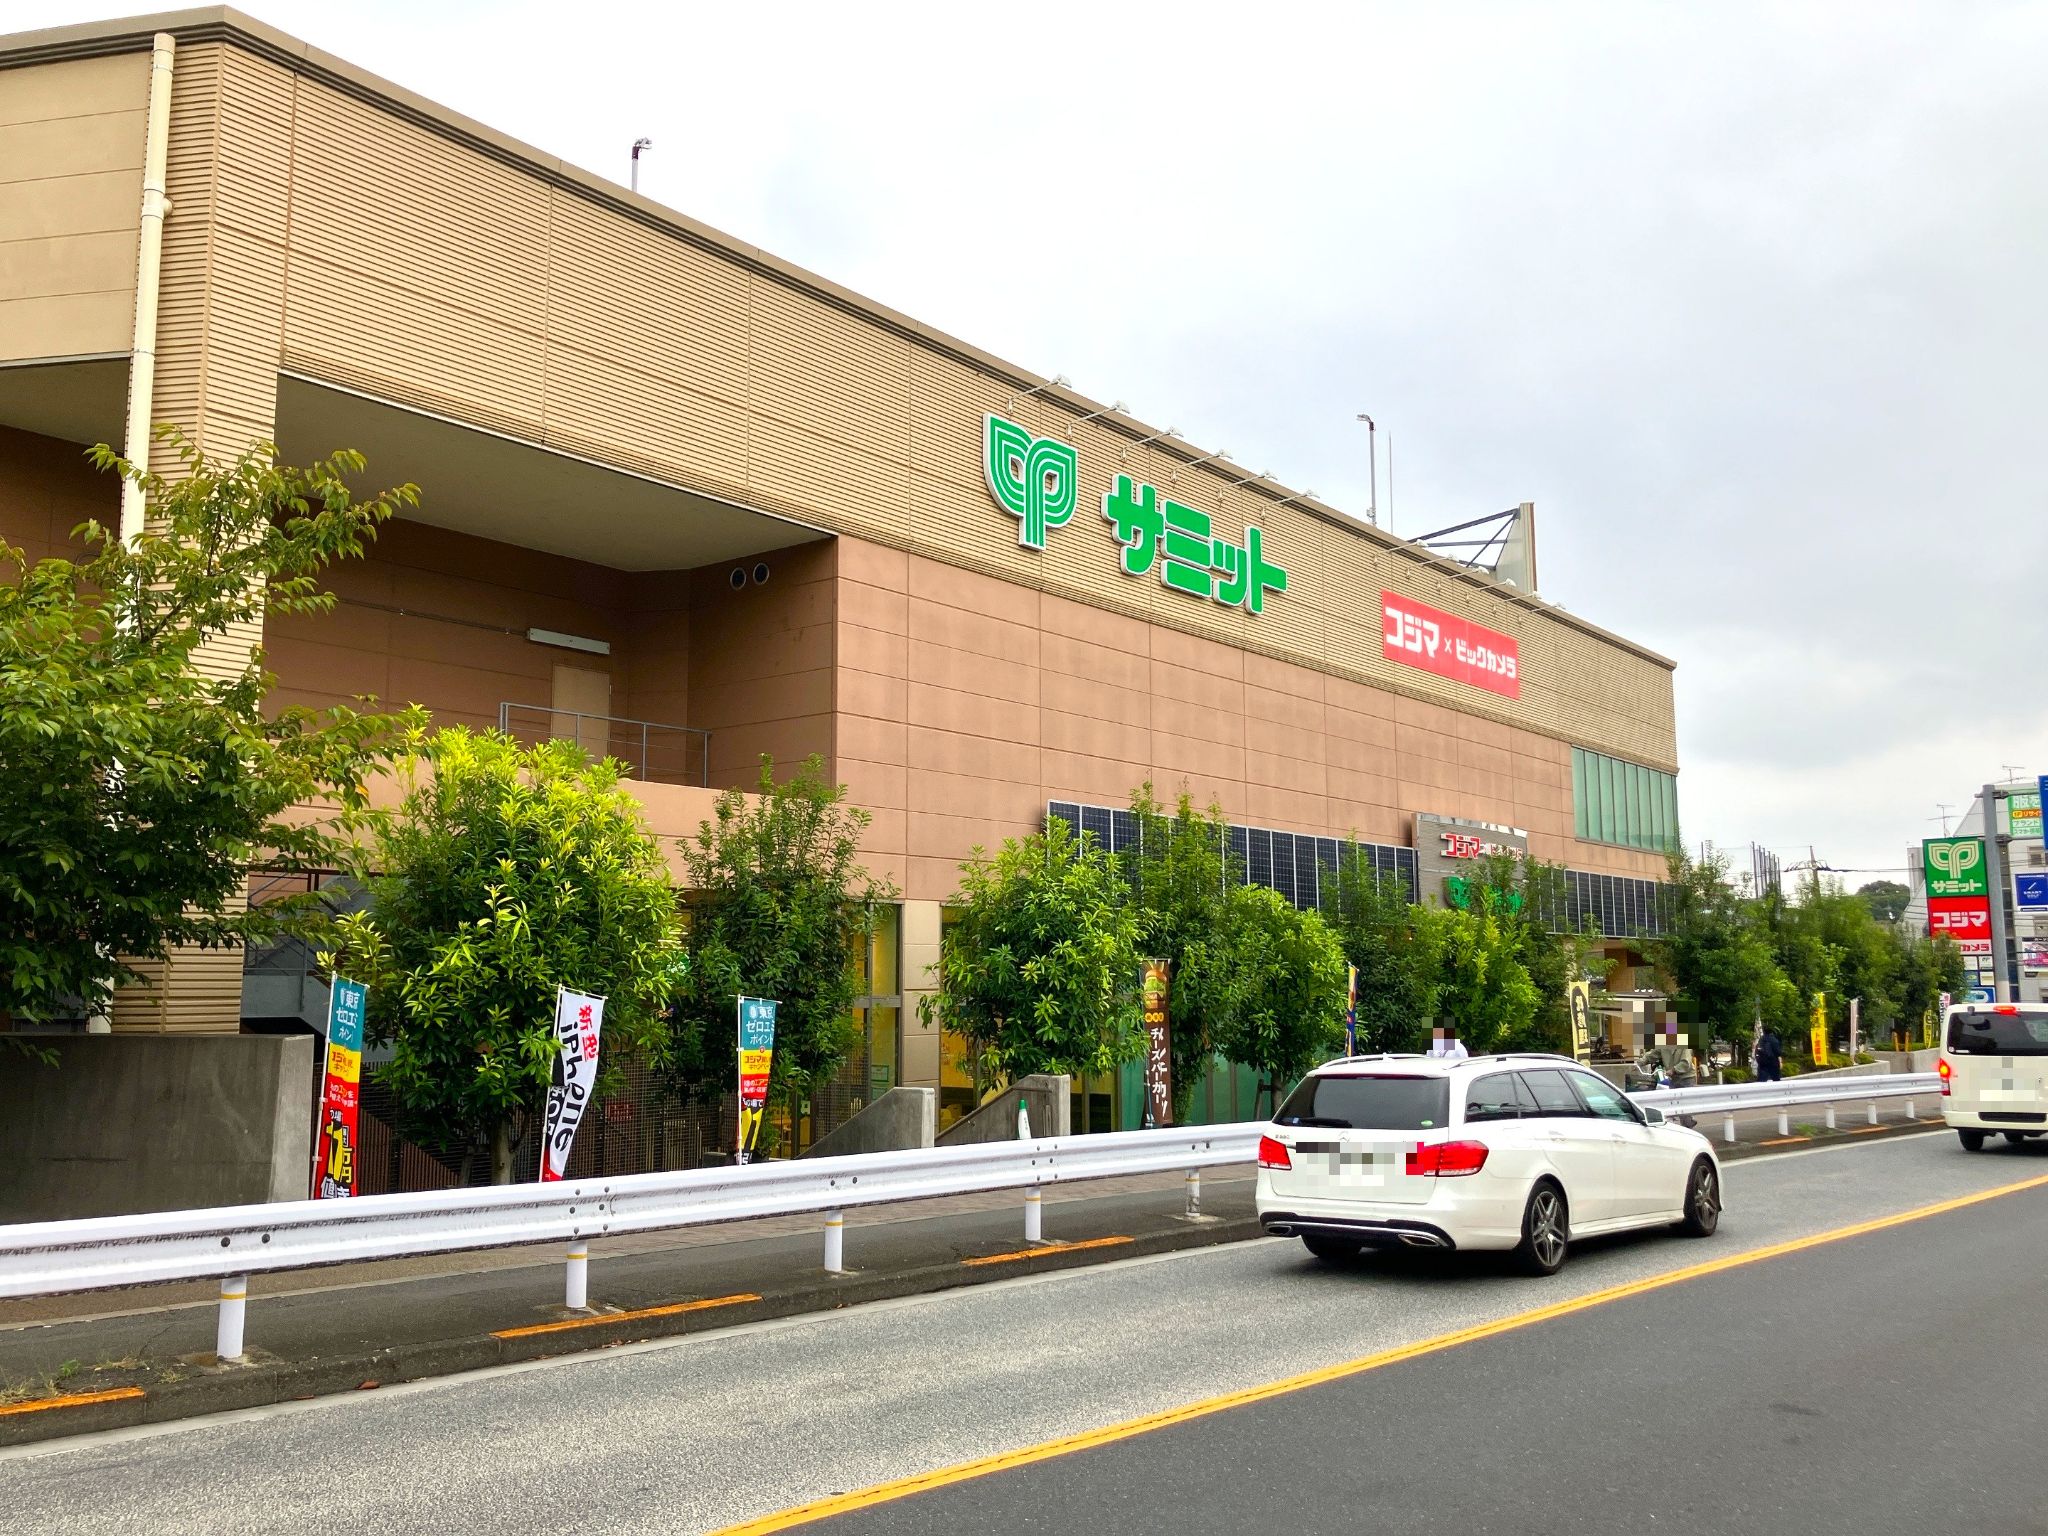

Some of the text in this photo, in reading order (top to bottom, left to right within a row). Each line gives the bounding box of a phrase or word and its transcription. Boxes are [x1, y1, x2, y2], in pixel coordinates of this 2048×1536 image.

[1101, 473, 1288, 615] サミット
[1385, 606, 1439, 658] コジマ
[1455, 638, 1517, 679] ビックカメラ
[1440, 832, 1480, 859] コジマ
[1931, 879, 1982, 893] サミット
[1932, 911, 1987, 928] コジマ
[1960, 943, 1990, 952] カメラ
[758, 1006, 774, 1019] 東京
[578, 1004, 599, 1062] 新型
[750, 1034, 774, 1045] ポイント
[555, 1021, 585, 1152] iPhone
